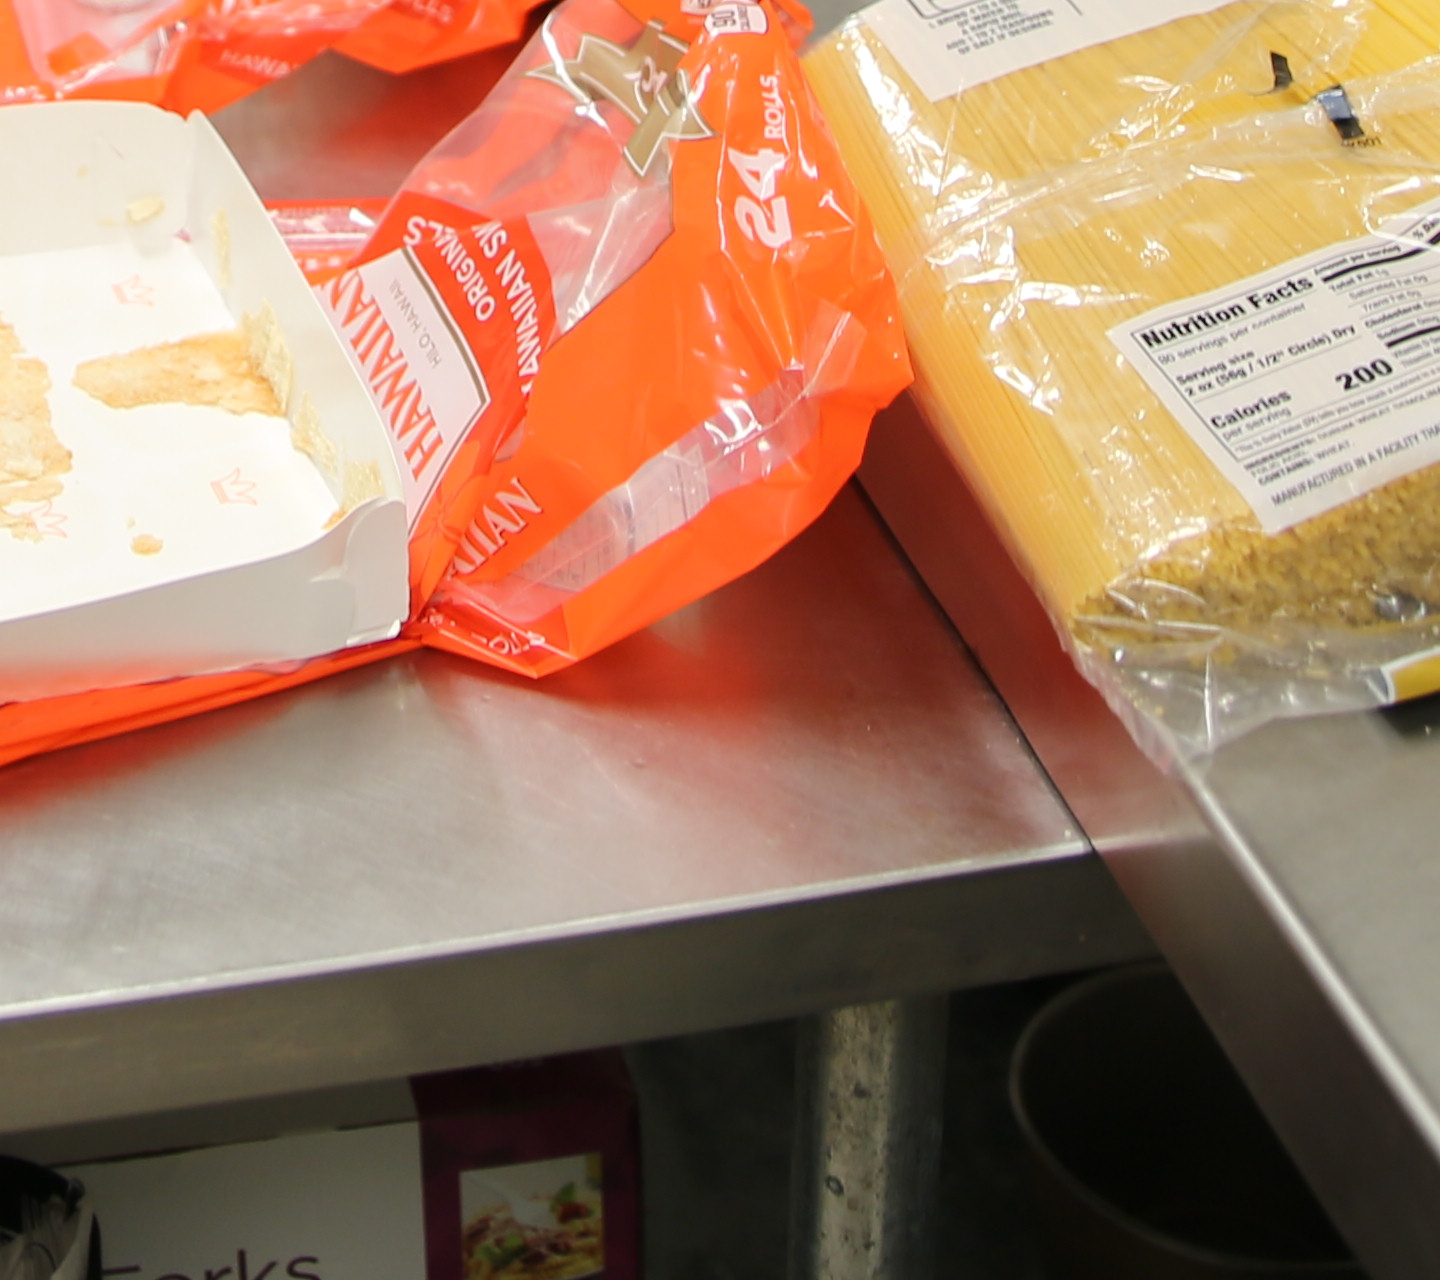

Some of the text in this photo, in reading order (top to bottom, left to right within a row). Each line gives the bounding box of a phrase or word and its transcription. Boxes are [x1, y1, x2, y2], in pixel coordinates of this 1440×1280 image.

[727, 72, 792, 249] 24 ROLLS
[495, 248, 542, 394] AWAIIAN
[1140, 278, 1314, 348] Nutrition Facts
[1177, 335, 1229, 359] servings
[1230, 326, 1249, 341] per
[1251, 302, 1306, 330] container
[323, 269, 443, 482] HAWAIIAN
[1176, 351, 1255, 386] Serving size
[1185, 387, 1195, 397] 2
[1198, 381, 1214, 392] oz
[1215, 367, 1248, 386] (56g
[1287, 334, 1332, 356] Circle)
[1331, 325, 1356, 340] Dry
[1211, 391, 1292, 428] Calories
[1335, 357, 1393, 391] 200
[1222, 407, 1292, 441] per serving
[1271, 462, 1354, 506] MANUFACTURED
[1353, 456, 1367, 472] IN
[1368, 451, 1378, 463] A
[1378, 433, 1420, 459] FACILITY
[447, 476, 542, 580] IIAN
